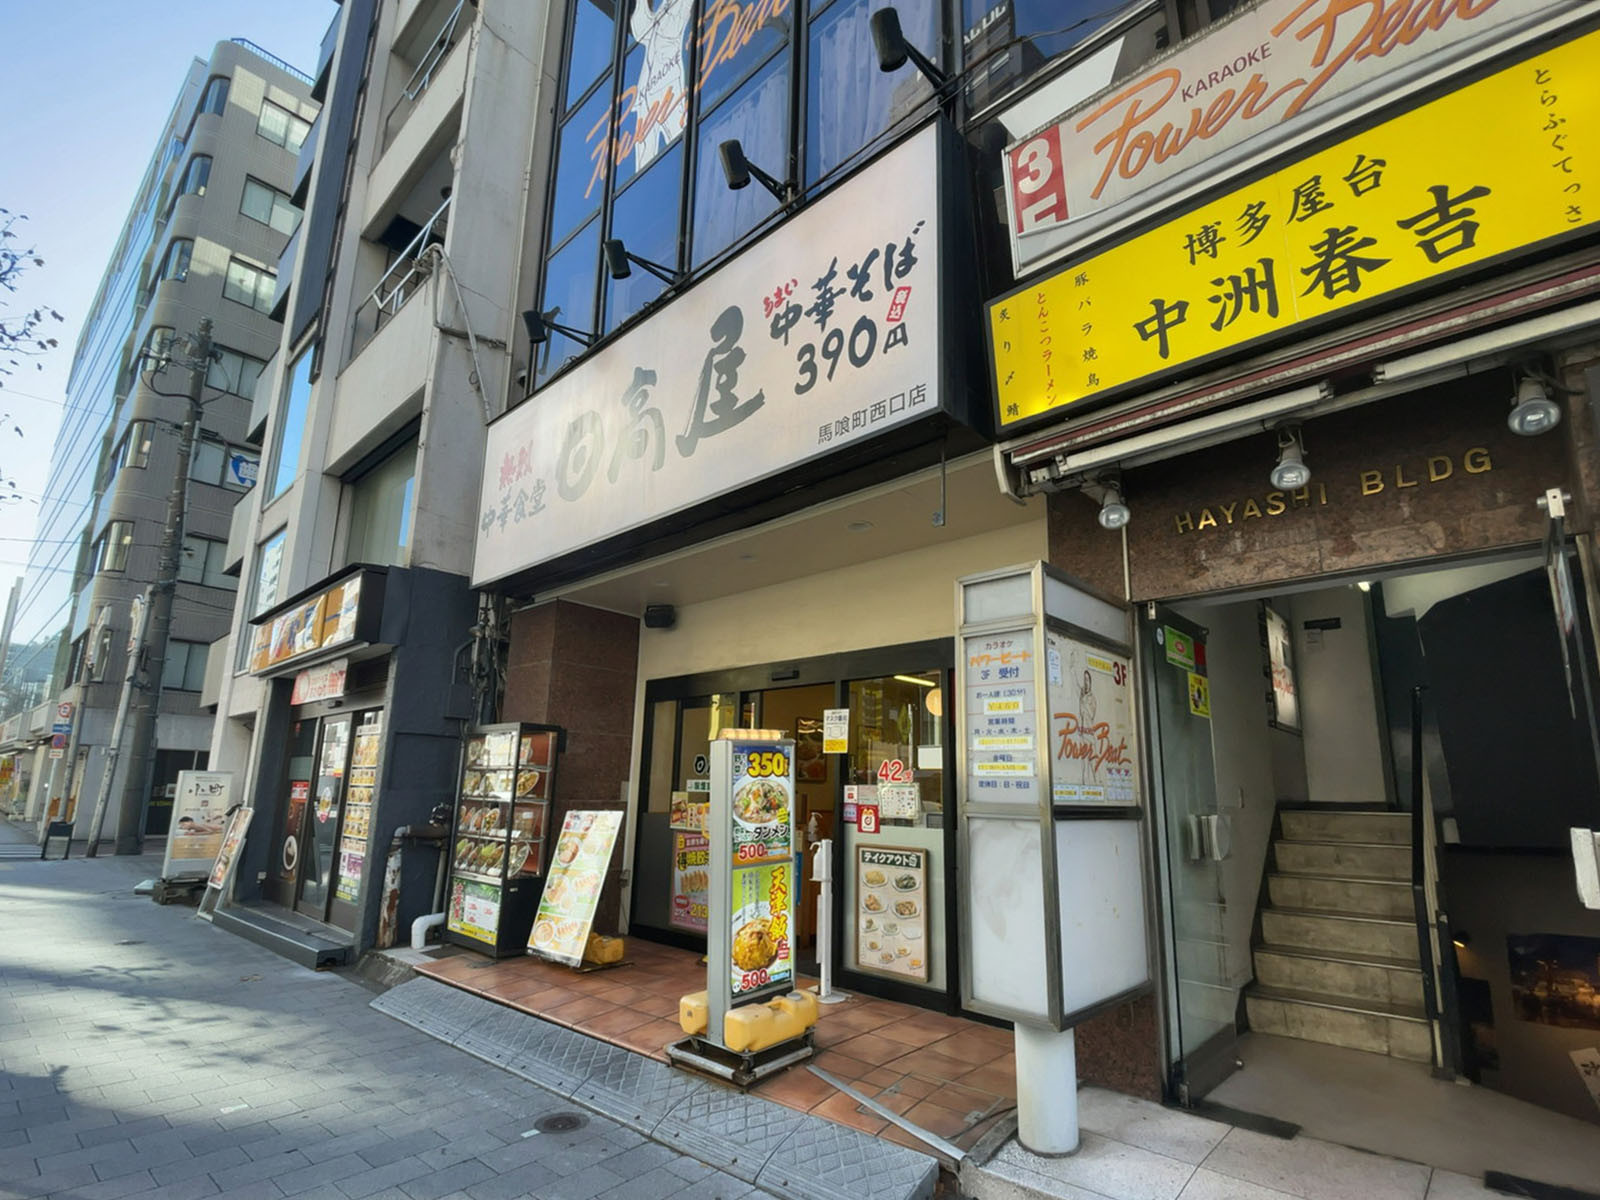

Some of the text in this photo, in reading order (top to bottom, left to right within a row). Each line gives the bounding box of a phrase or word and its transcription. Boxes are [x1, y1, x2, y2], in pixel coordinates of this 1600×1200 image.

[1181, 41, 1273, 102] KARAOKE
[1076, 68, 1300, 200] Power
[1535, 68, 1583, 223] とらふぐてっさ
[1182, 154, 1388, 265] 博多屋台
[763, 278, 798, 319] うまい
[769, 220, 926, 346] 中華そば
[1132, 185, 1492, 359] 中洲春吉
[794, 314, 909, 396] 390円
[1036, 292, 1057, 406] とんこつラーメン
[1074, 271, 1100, 388] 豚バラ焼鳥
[555, 305, 766, 502] 日高屋
[817, 383, 927, 445] 馬喰町西口店
[481, 478, 547, 539] 中華食堂
[1173, 447, 1493, 534] HAYASHI BLDG
[970, 651, 1033, 667] パワービート
[985, 640, 1014, 650] カラオケ
[998, 666, 1020, 679] 受付
[1112, 661, 1127, 687] 3F
[754, 826, 788, 839] タンメン
[863, 852, 910, 866] テイクアウト
